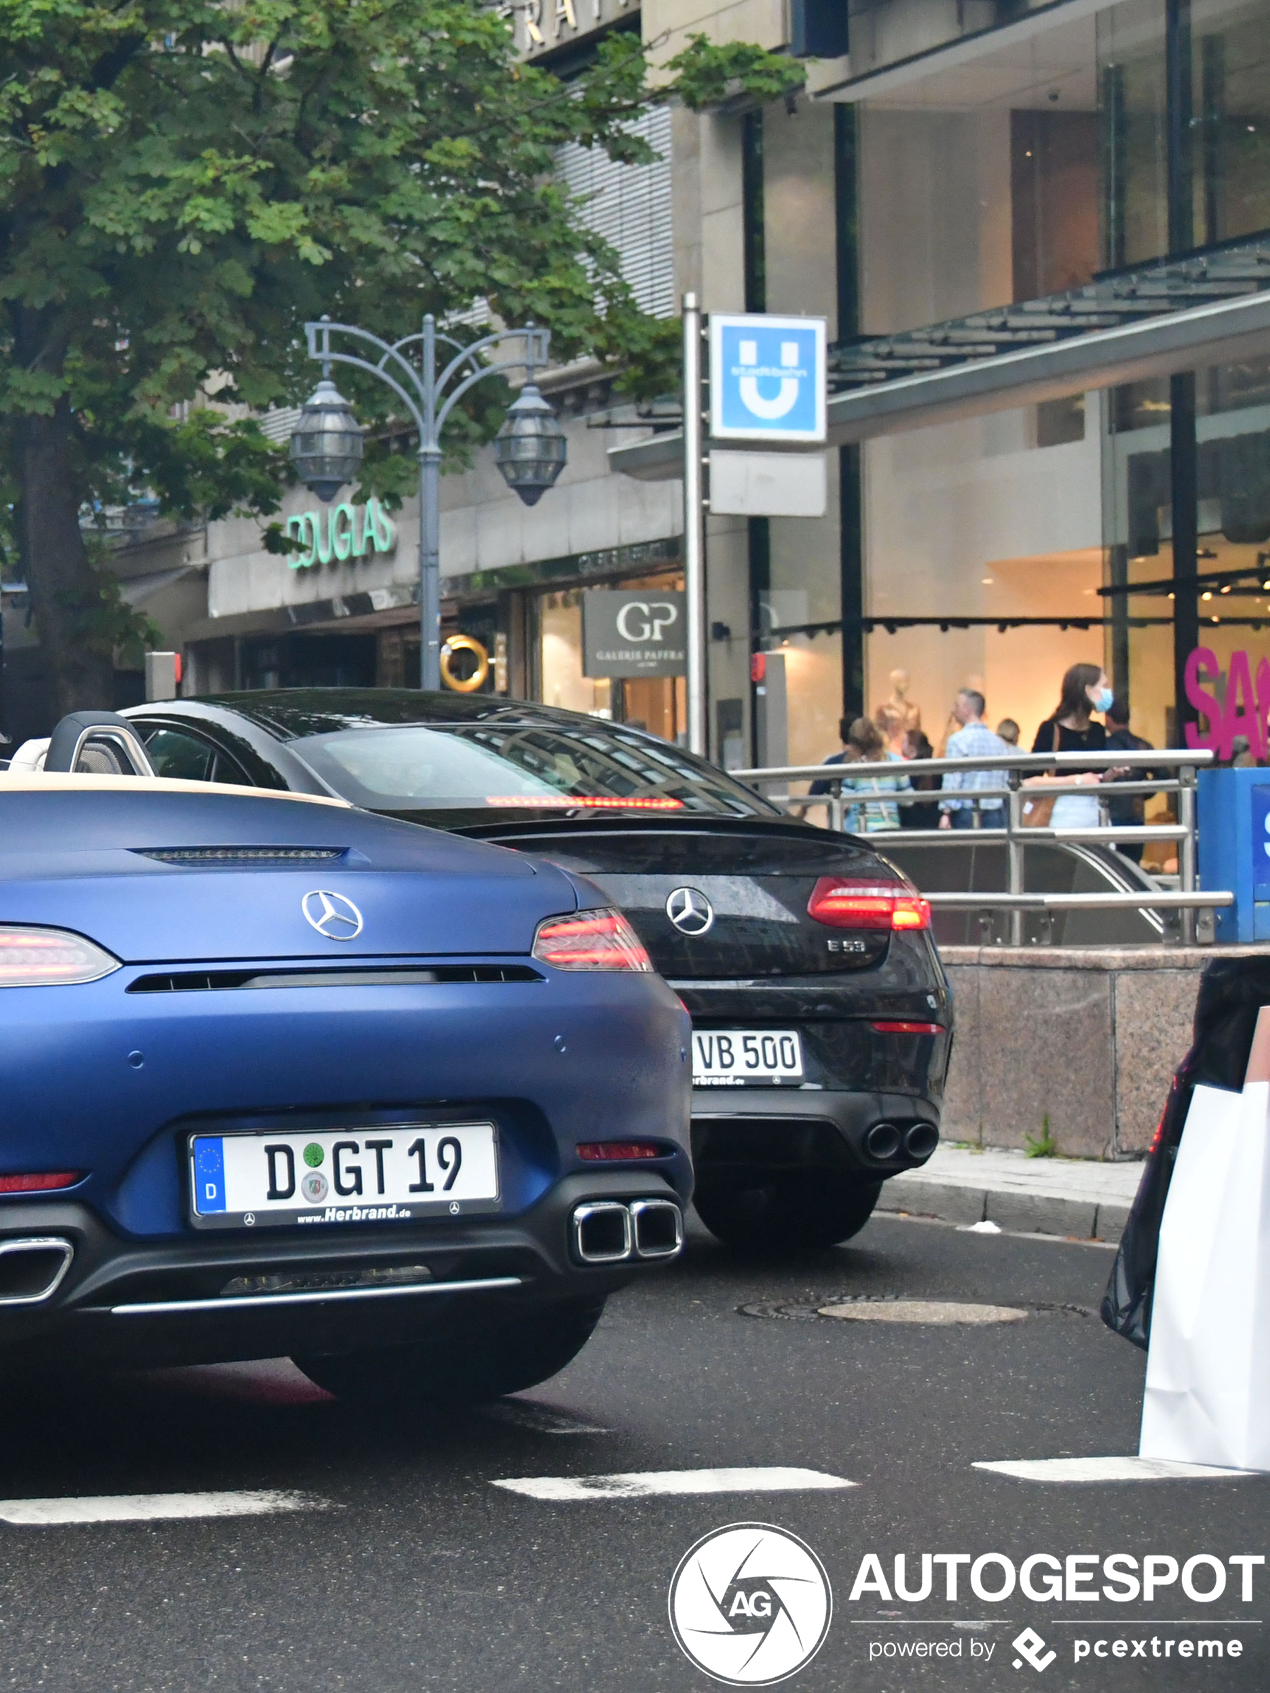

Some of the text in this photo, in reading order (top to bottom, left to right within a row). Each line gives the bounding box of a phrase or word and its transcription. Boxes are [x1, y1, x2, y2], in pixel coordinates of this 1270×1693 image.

[739, 340, 799, 420] U
[287, 498, 392, 569] DOUGLAS
[616, 602, 678, 642] GP
[596, 651, 642, 661] GALERIE
[827, 940, 866, 953] E 53
[697, 1035, 797, 1070] VB 500
[264, 1143, 296, 1200] D
[332, 1138, 394, 1196] GT
[407, 1136, 463, 1193] 19
[205, 1183, 217, 1199] D
[297, 1205, 411, 1224] www.Herbrand.de
